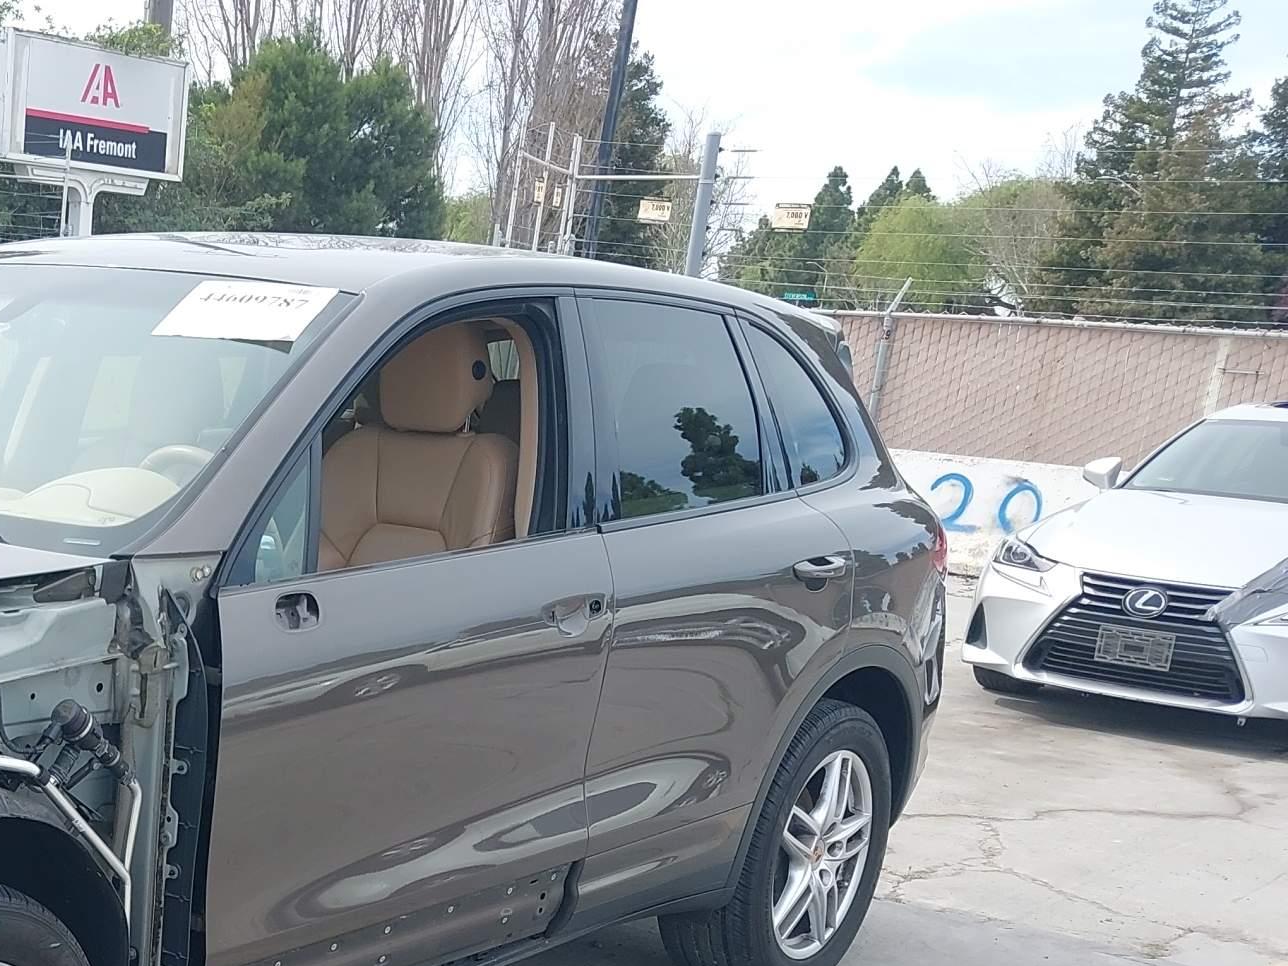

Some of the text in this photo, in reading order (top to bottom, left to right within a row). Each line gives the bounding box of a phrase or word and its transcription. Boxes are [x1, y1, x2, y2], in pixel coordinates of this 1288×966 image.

[58, 128, 137, 159] IAA Fremont
[786, 211, 803, 219] 7,000
[199, 292, 310, 309] 44609787
